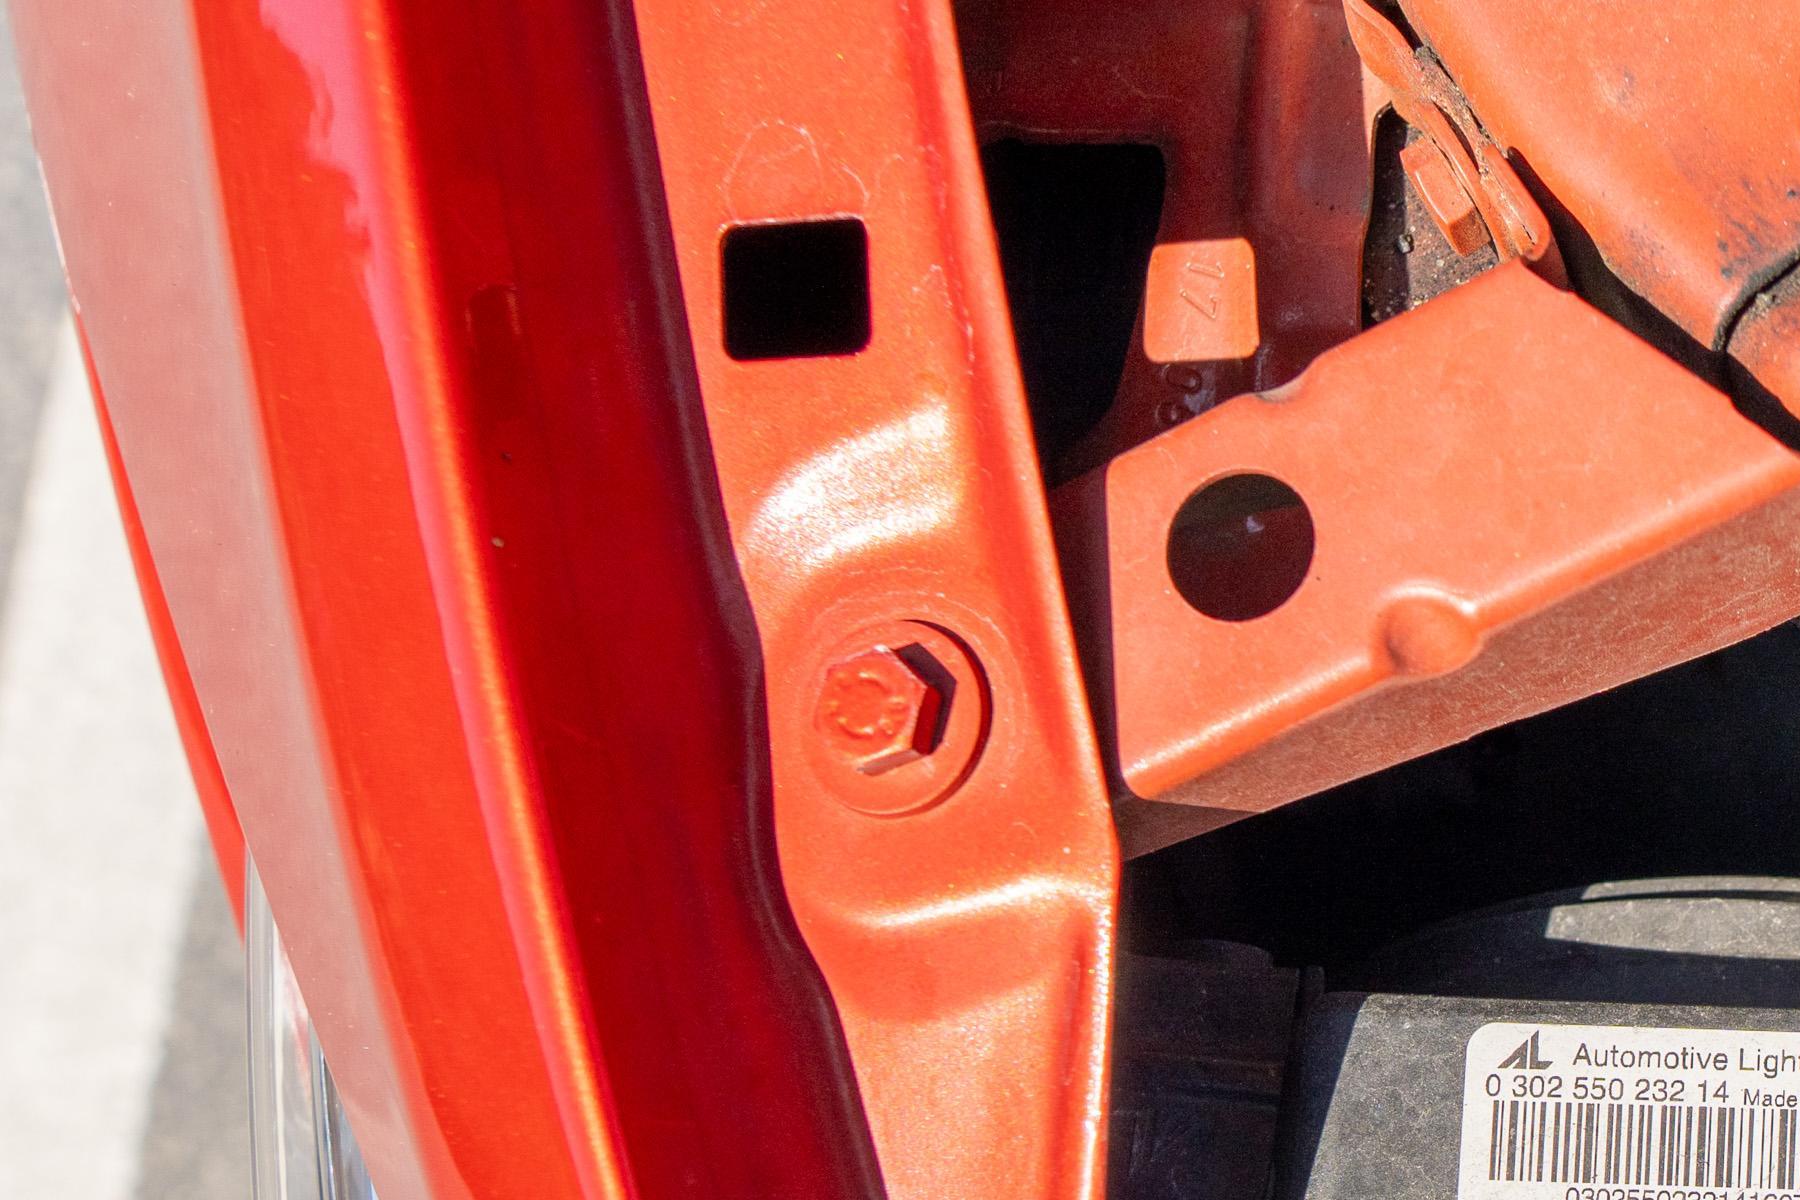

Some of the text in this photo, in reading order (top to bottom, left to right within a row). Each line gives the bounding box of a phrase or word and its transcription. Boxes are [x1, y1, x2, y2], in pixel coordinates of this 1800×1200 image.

[1572, 1042, 1728, 1071] Automotive
[1485, 1073, 1729, 1103] 0 302 550 232 14
[1743, 1088, 1797, 1108] Made
